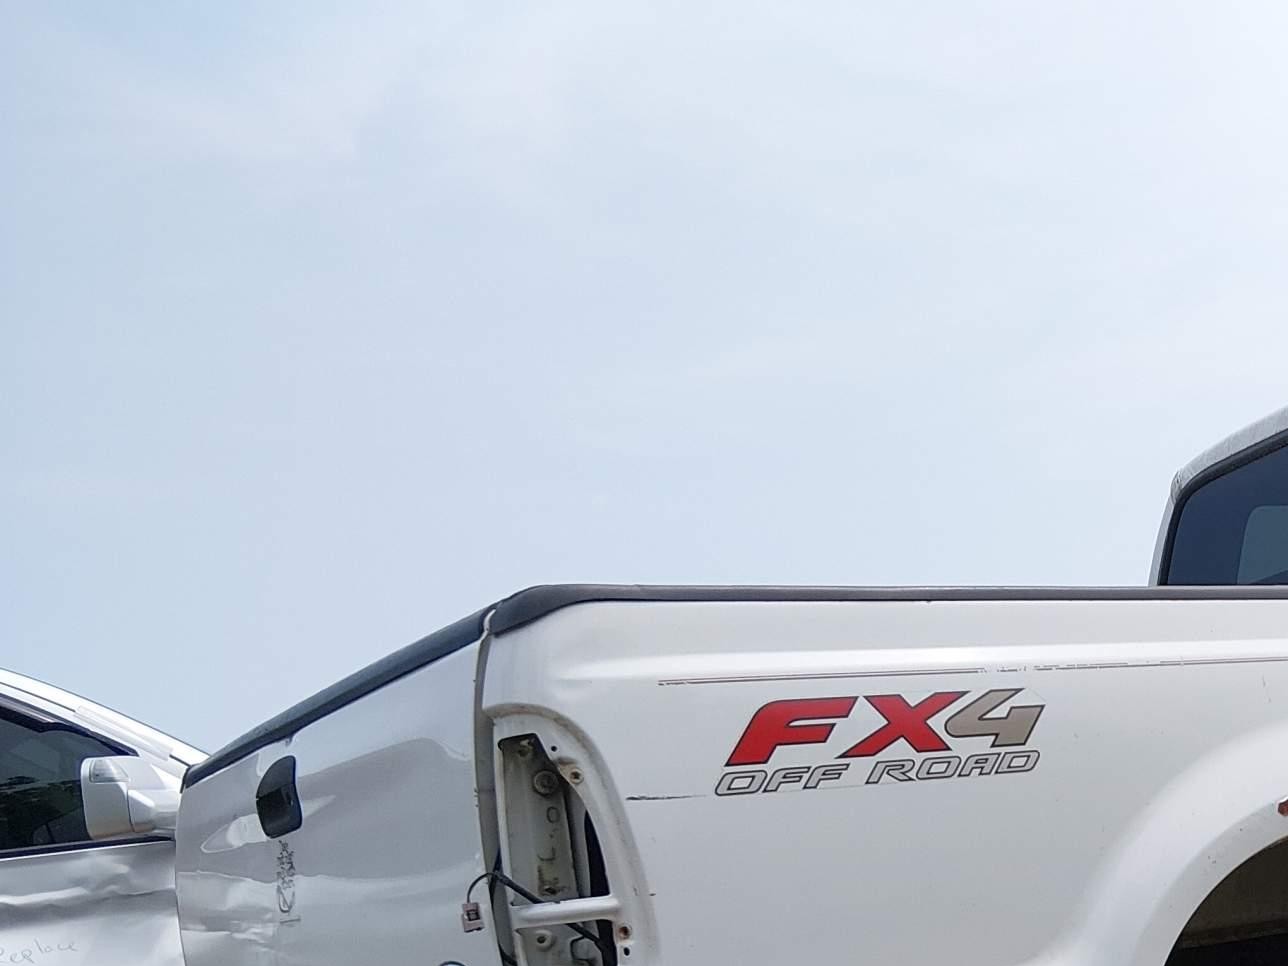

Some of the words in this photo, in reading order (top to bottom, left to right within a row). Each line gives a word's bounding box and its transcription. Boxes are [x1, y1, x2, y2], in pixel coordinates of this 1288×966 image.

[724, 687, 1046, 767] FX4
[715, 762, 851, 797] OFF
[865, 749, 1042, 786] ROAD
